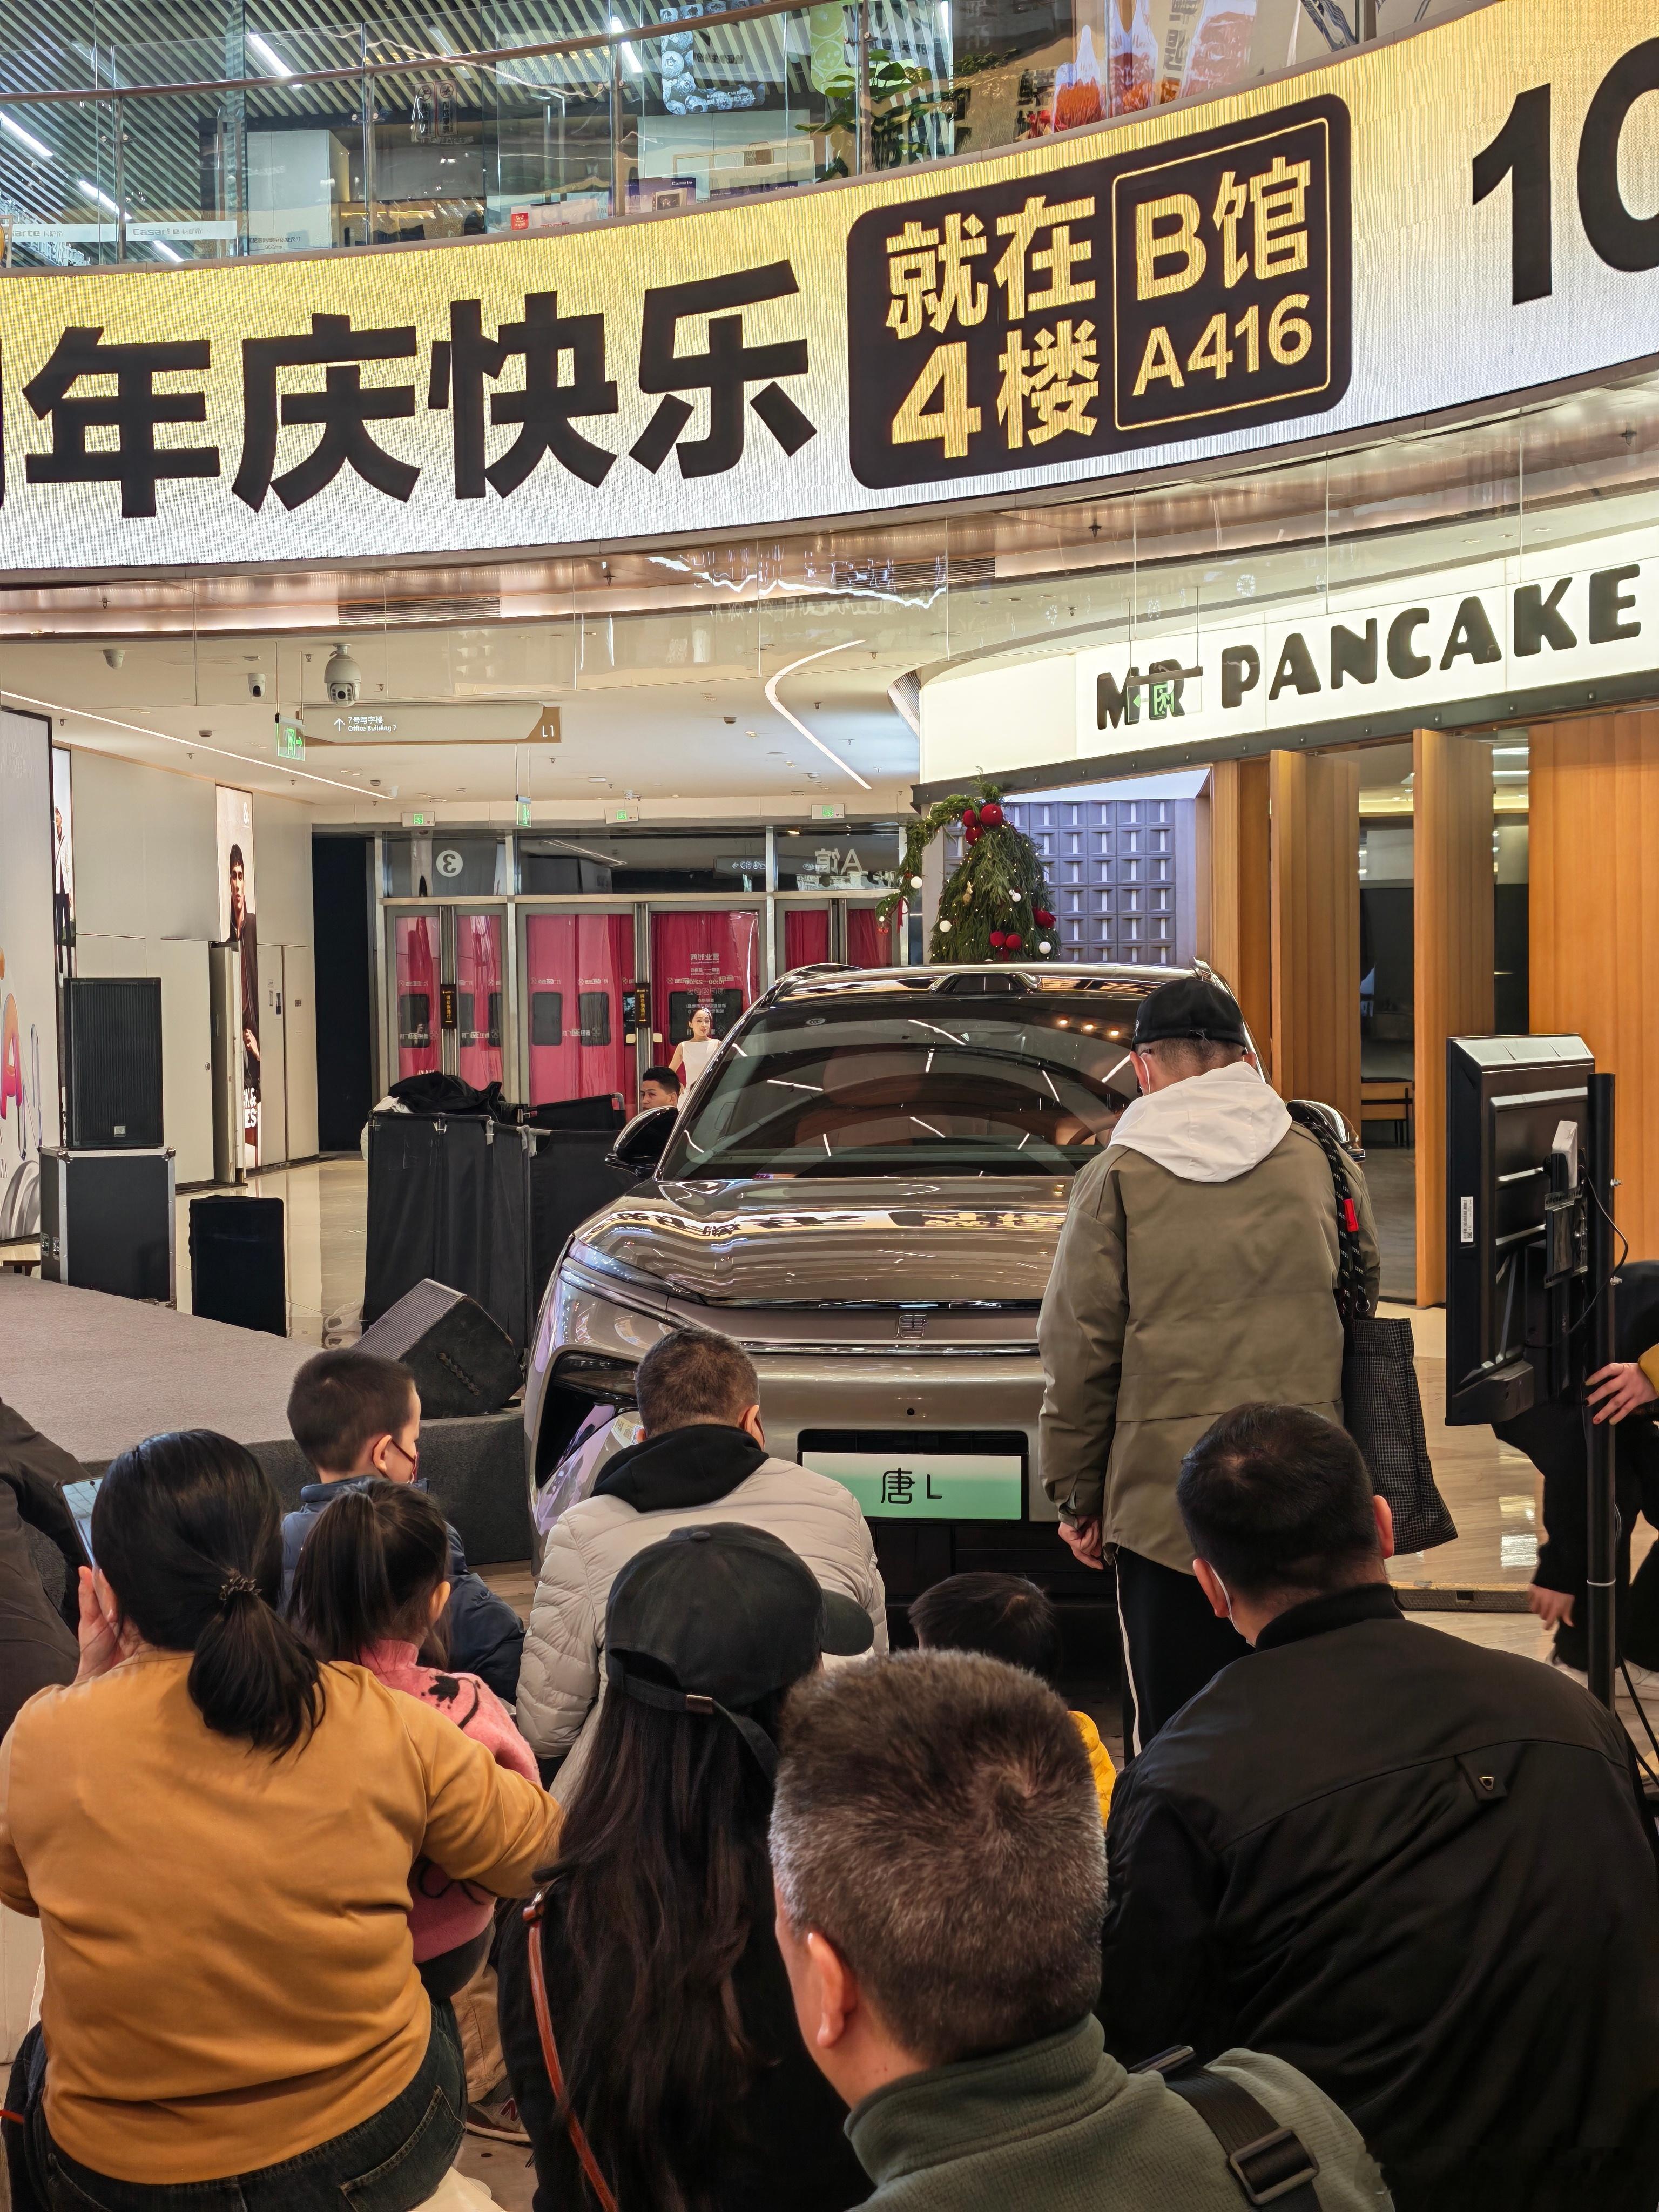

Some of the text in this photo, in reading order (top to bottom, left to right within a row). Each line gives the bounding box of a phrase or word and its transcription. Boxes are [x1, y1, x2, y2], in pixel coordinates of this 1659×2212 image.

[886, 194, 1095, 340] 就在
[1136, 156, 1311, 301] B馆
[0, 260, 817, 518] 年庆快乐
[891, 319, 1099, 460] 4楼
[1132, 293, 1313, 397] A416
[1097, 563, 1642, 730] MR PANCAKE
[348, 716, 383, 724] 7号写字楼
[542, 725, 554, 737] L1
[881, 1467, 942, 1505] 唐 L
